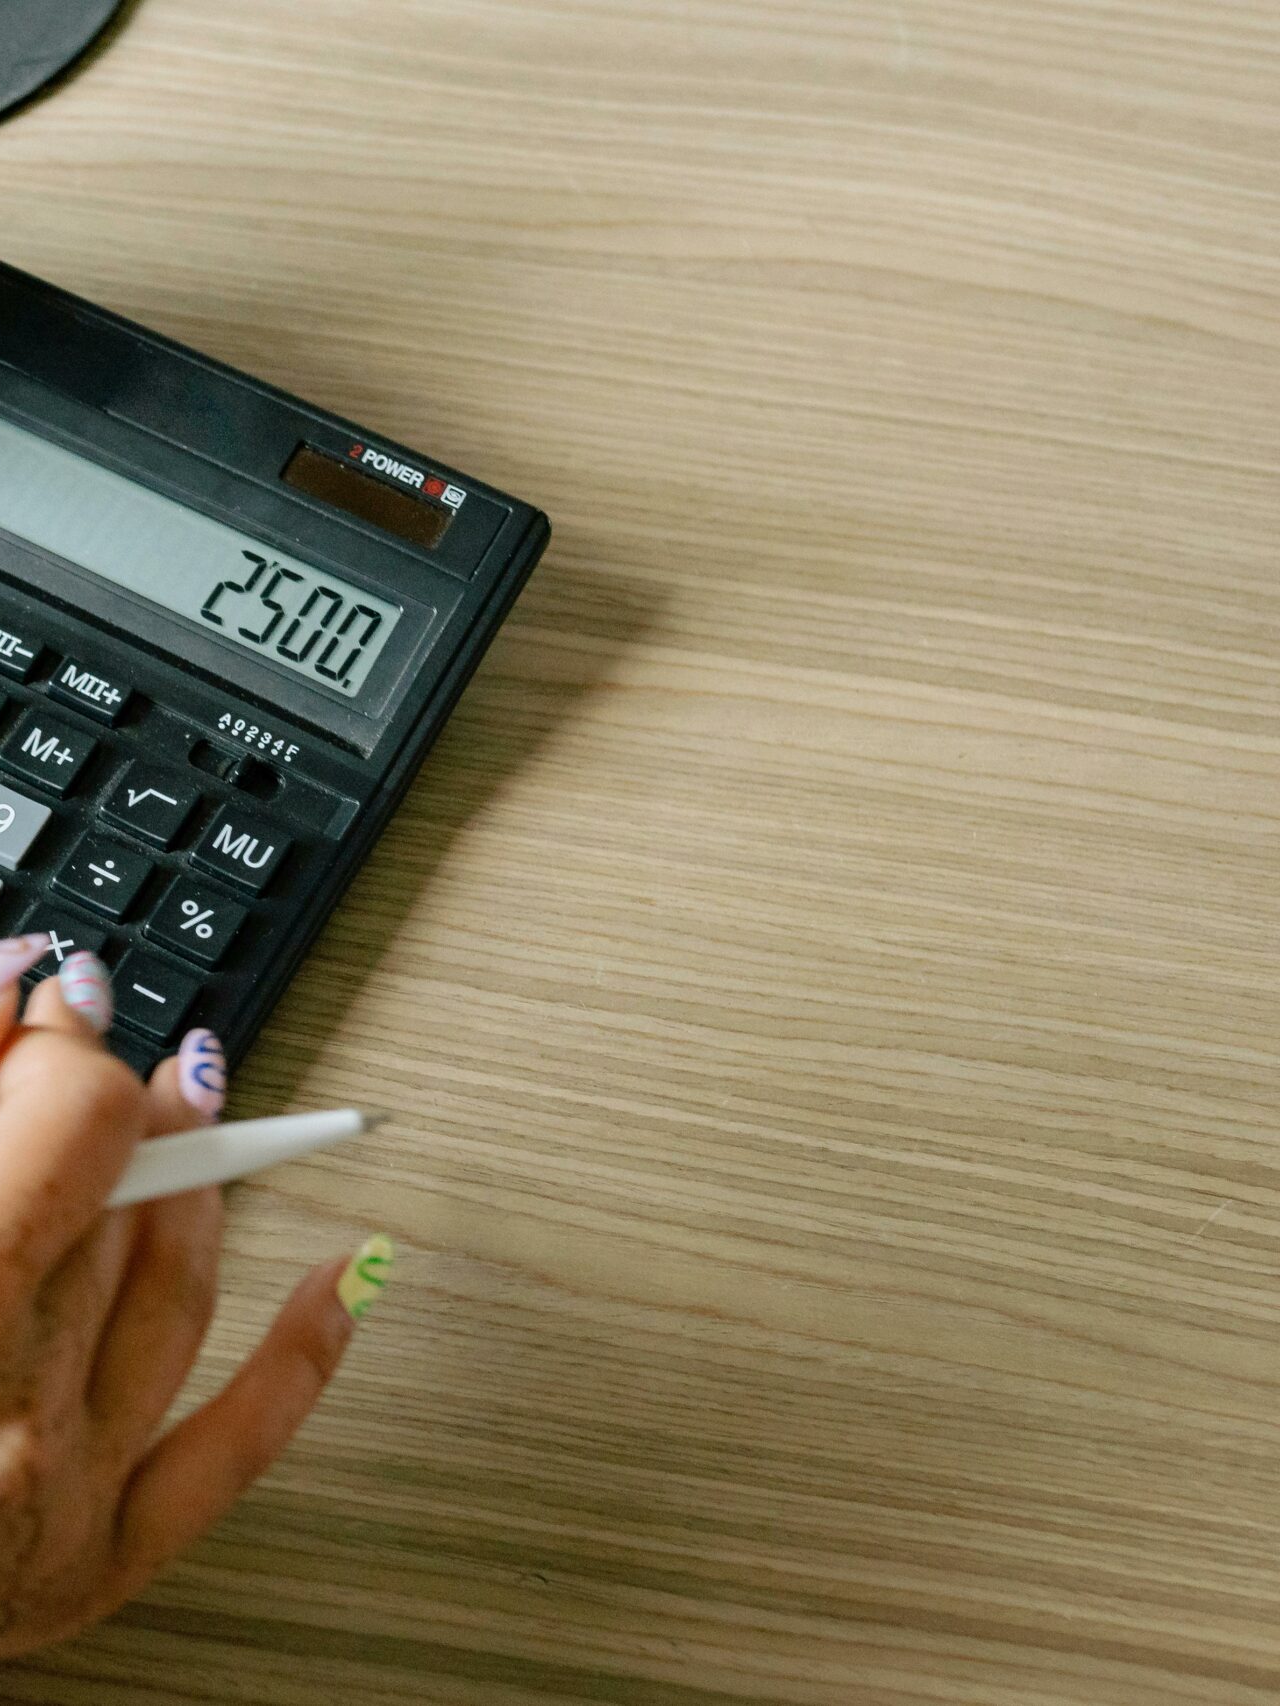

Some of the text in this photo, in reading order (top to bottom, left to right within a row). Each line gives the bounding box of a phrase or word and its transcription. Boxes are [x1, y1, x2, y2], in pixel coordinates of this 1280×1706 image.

[349, 444, 425, 489] 2 POWER
[22, 727, 73, 766] M+
[212, 823, 275, 869] MU
